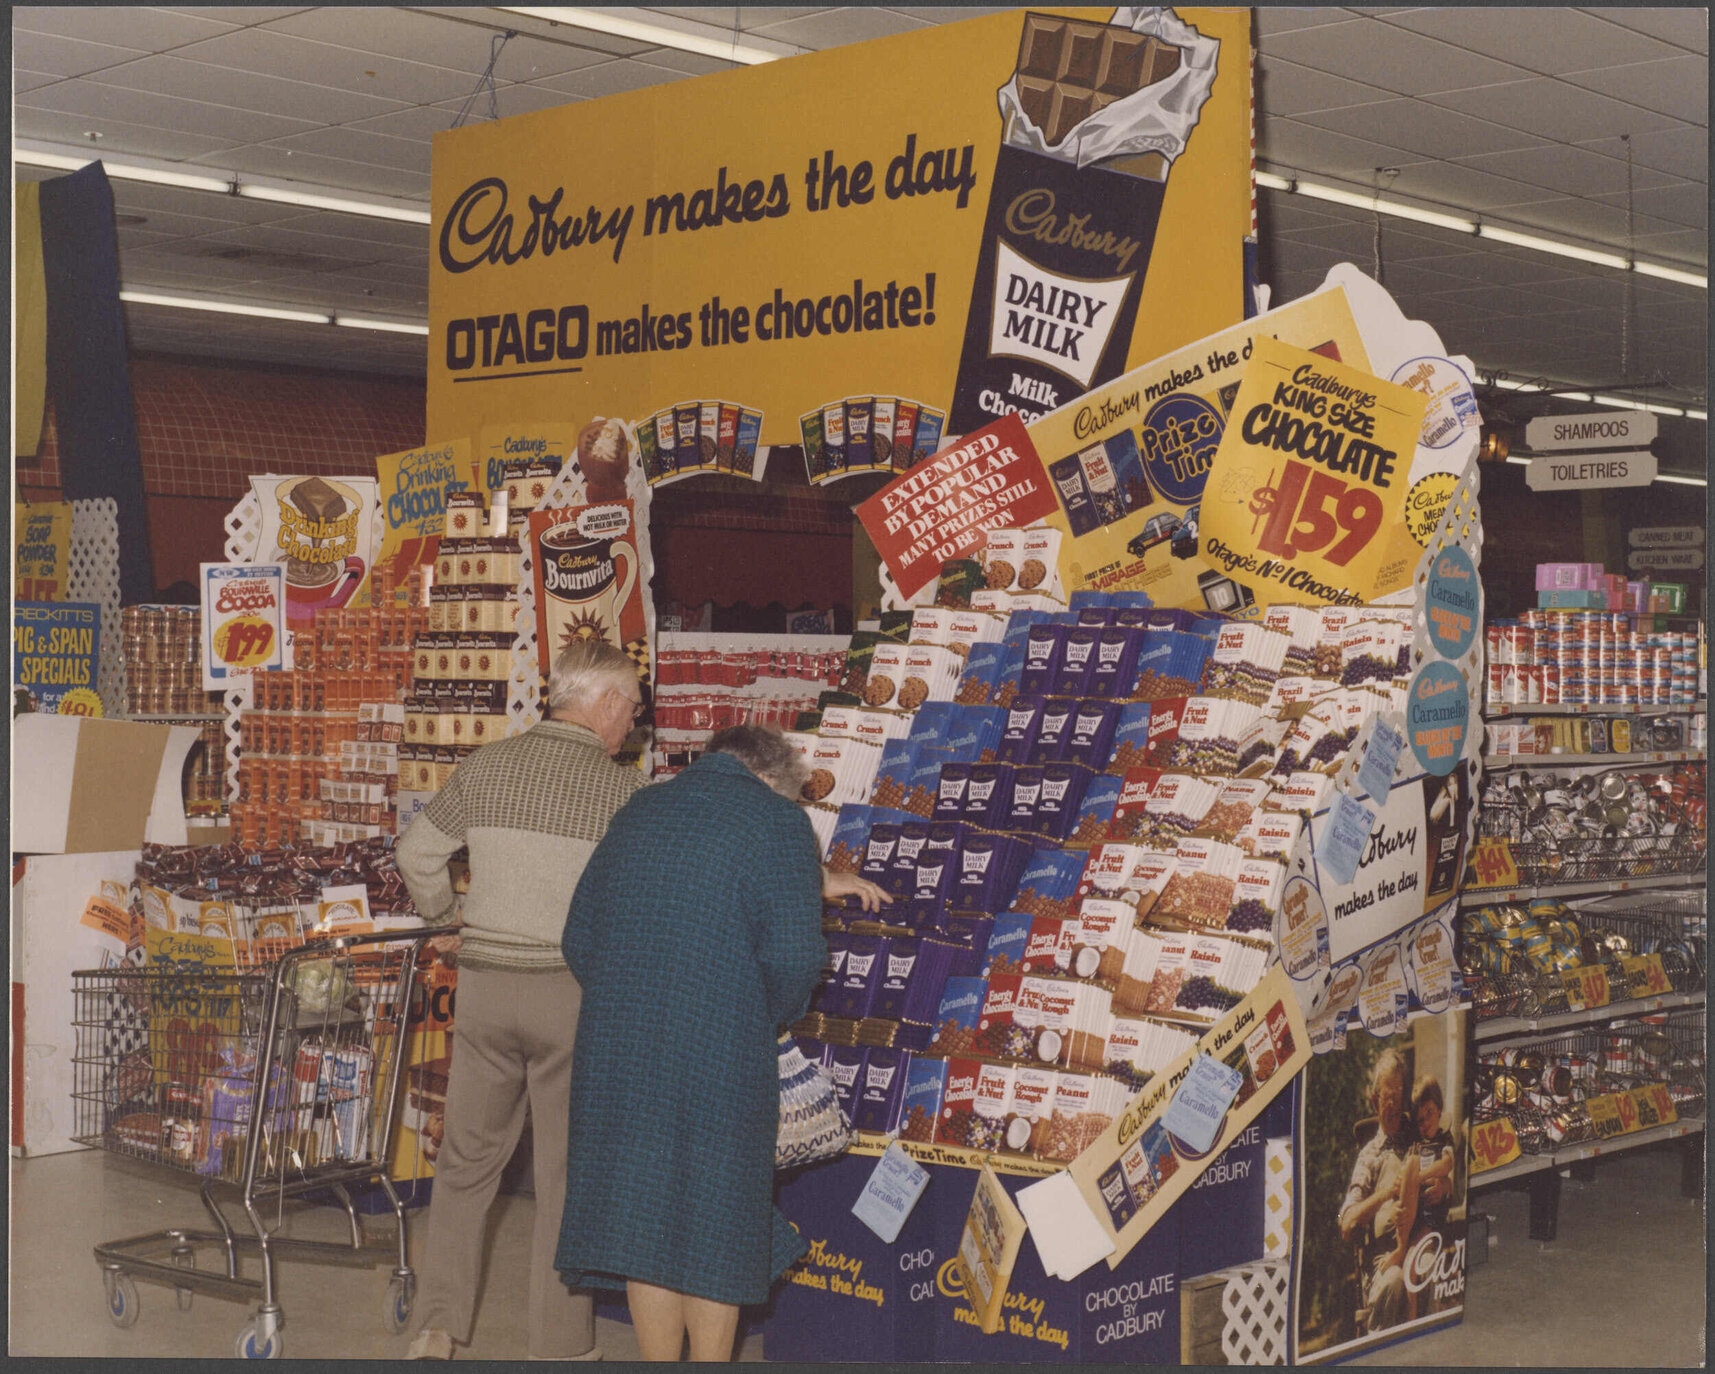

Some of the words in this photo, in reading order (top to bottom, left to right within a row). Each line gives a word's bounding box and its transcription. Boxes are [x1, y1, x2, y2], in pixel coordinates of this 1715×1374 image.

[439, 177, 633, 273] Cadbury
[643, 167, 790, 236] makes
[805, 150, 874, 211] the
[885, 133, 976, 209] day
[1006, 189, 1140, 272] Cadbury
[1005, 274, 1107, 328] DAIRY
[446, 305, 589, 370] OTAGO
[596, 304, 692, 355] makes
[700, 296, 749, 345] the
[755, 272, 937, 341] chocolate!
[1003, 310, 1084, 361] MILK
[1008, 373, 1059, 408] Milk
[1074, 391, 1139, 439] Cadbury
[1145, 364, 1204, 402] makes
[1207, 350, 1239, 374] the
[1242, 337, 1253, 361] d
[1292, 364, 1377, 408] Cadburys
[979, 390, 1050, 424] Choco
[1273, 382, 1326, 418] KING
[1327, 402, 1375, 439] SIZE
[1142, 412, 1216, 461] Prize
[1422, 416, 1457, 447] Caramello
[1554, 420, 1629, 440] SHAMPOOS
[1241, 403, 1397, 488] CHOCOLATE
[1164, 445, 1219, 482] Tim
[1551, 461, 1628, 481] TOILETRIES
[396, 465, 456, 493] Drinking
[880, 433, 1000, 515] EXTENDED
[884, 509, 912, 537] BY
[909, 446, 1020, 518] POPULAR
[907, 474, 1007, 541] DEMAND
[279, 501, 358, 539] Drinking
[898, 535, 938, 570] MANY
[939, 496, 998, 538] PRIZES
[997, 479, 1038, 506] STILL
[25, 525, 51, 544] SOAP
[931, 543, 955, 564] TO
[952, 530, 979, 556] BE
[977, 509, 1016, 536] WON
[1023, 538, 1048, 549] Crunch
[17, 544, 57, 564] POWDER
[277, 529, 358, 564] Chocolate
[986, 540, 1014, 550] Crunch
[1206, 538, 1256, 572] Otago's
[558, 553, 598, 569] Cadbury
[545, 556, 614, 591] Bournvita
[1091, 560, 1147, 590] MIRAGE
[216, 594, 276, 613] COCOA
[1431, 580, 1475, 611] Caramello
[912, 620, 938, 629] Crunch
[950, 622, 978, 632] Crunch
[1322, 617, 1347, 625] Brazil
[49, 627, 93, 655] SPAN
[1220, 632, 1244, 641] Fruit
[1343, 635, 1372, 649] Raisin
[20, 656, 91, 684] SPECIALS
[872, 655, 899, 665] Crunch
[905, 657, 932, 667] Crunch
[1277, 687, 1303, 696] Brazil
[1186, 708, 1209, 716] Fruit
[1189, 716, 1207, 725] Nut
[1412, 701, 1465, 724] Caramello
[821, 720, 848, 729] Crunch
[856, 724, 883, 734] Crunch
[813, 750, 841, 759] Crunch
[1155, 783, 1179, 792] Fruit
[1285, 786, 1316, 797] Raisin
[1258, 827, 1290, 838] Raisin
[1176, 849, 1207, 859] Peanut
[1359, 824, 1416, 869] dbury
[1101, 854, 1124, 864] Fruit
[1237, 874, 1270, 886] Raisin
[1335, 891, 1374, 920] makes
[1378, 880, 1396, 901] the
[1398, 872, 1418, 892] day
[1080, 913, 1117, 923] Coconut
[1081, 922, 1111, 932] Rough
[988, 928, 1027, 949] Caramello
[1190, 950, 1221, 963] Raisin
[1289, 950, 1316, 976] Caramello
[939, 994, 978, 1014] Caramello
[989, 990, 1013, 1001] Energy
[1040, 994, 1075, 1006] Coconut
[982, 1003, 1015, 1015] Chocolate
[1041, 1003, 1070, 1015] Rough
[1366, 1011, 1394, 1032] Caramello
[1109, 1034, 1139, 1046] Raisin
[949, 1076, 974, 1088] Energy
[980, 1076, 1005, 1088] Fruit
[1118, 1082, 1166, 1145] Cadbury
[1214, 1028, 1234, 1050] the
[1235, 1007, 1255, 1033] day
[984, 1088, 1004, 1100] Nut
[1013, 1082, 1048, 1094] Coconut
[1015, 1092, 1042, 1103] Rough
[1056, 1086, 1090, 1098] Peanut
[1179, 1090, 1220, 1120] Caramello
[868, 1181, 904, 1213] Caramello
[799, 1240, 863, 1282] dbury
[830, 1274, 853, 1295] the
[855, 1280, 884, 1307] day
[1086, 1274, 1175, 1313] CHOCOLATE
[1434, 1276, 1464, 1299] mak
[1123, 1303, 1137, 1319] BY
[1009, 1313, 1034, 1337] the
[1036, 1321, 1068, 1350] day
[1096, 1309, 1166, 1345] CADBURY
